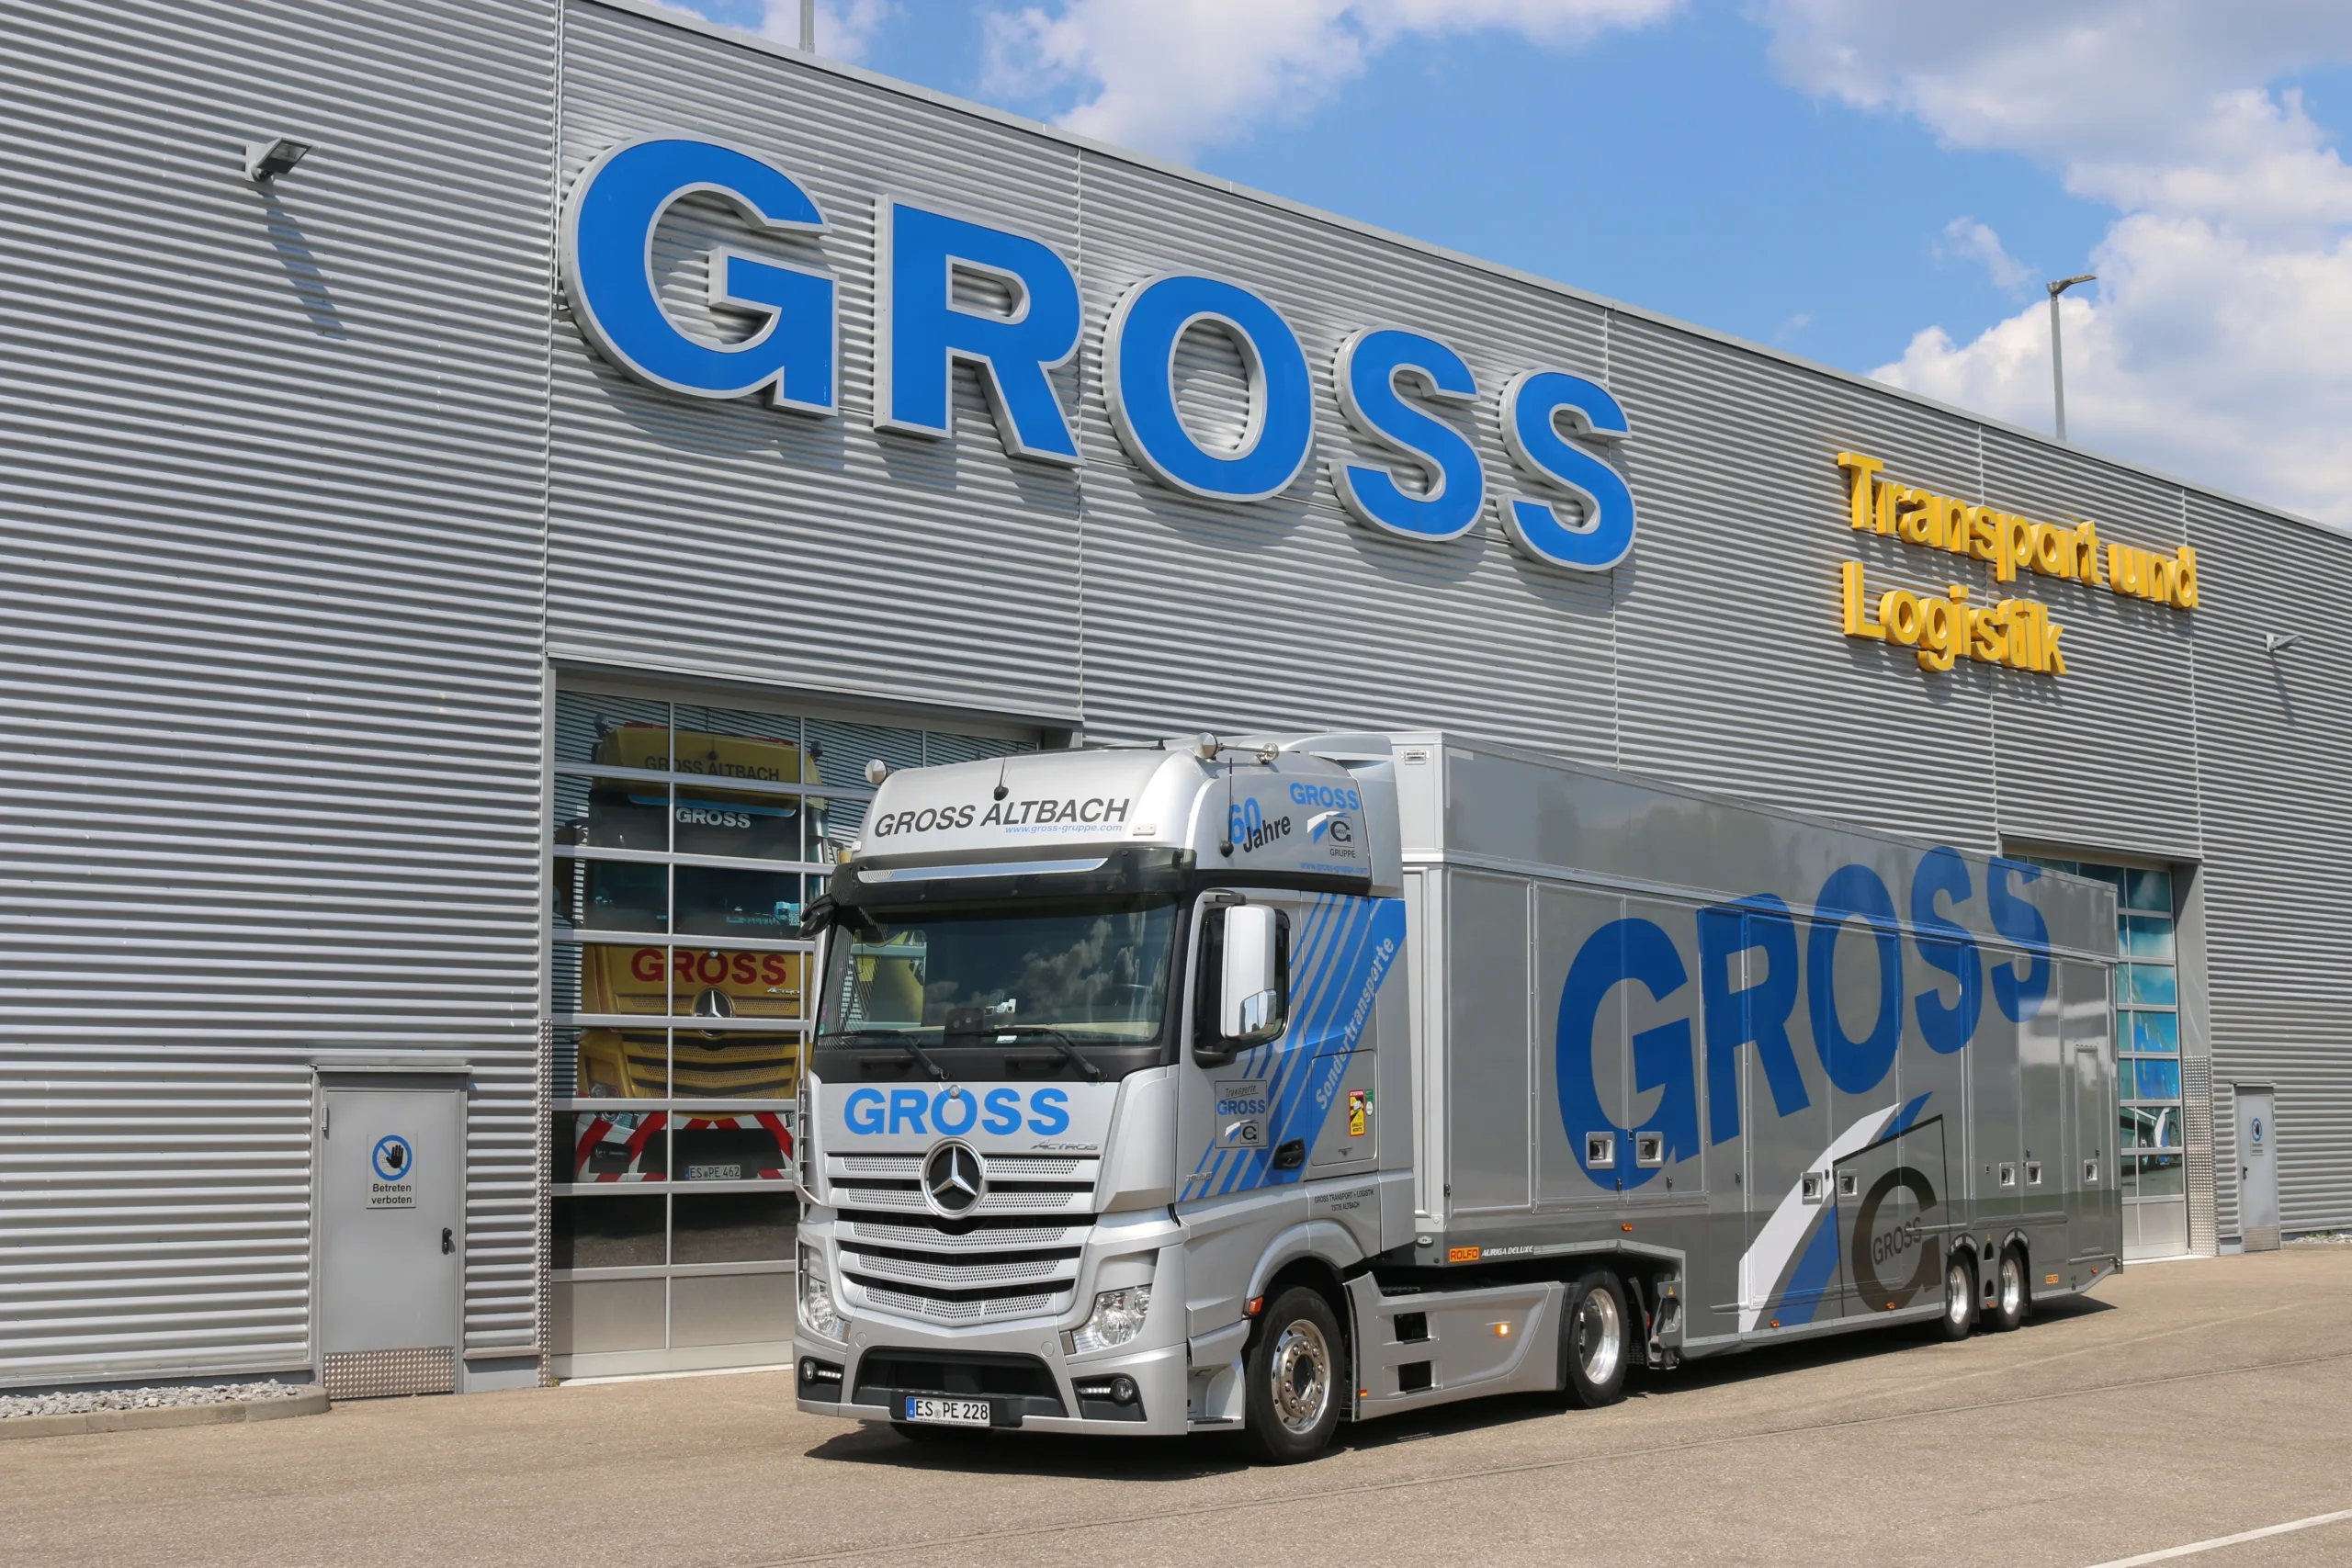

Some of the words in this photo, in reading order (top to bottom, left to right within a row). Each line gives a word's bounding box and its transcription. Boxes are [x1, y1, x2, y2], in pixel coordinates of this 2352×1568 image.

[560, 131, 1637, 571] GROSS
[1838, 451, 2103, 586] Transport
[2108, 543, 2199, 610] und
[1842, 561, 2067, 675] Logistik
[645, 755, 704, 774] GROSS
[708, 762, 780, 781] ALTBACH
[1289, 782, 1360, 811] GROSS
[676, 807, 751, 829] GROSS
[875, 805, 977, 838] GROSS
[979, 797, 1130, 827] ALTBACH
[1005, 824, 1123, 834] www.gross-gruppe.com
[1227, 797, 1261, 845] 60
[1243, 816, 1291, 853] Jahre
[1329, 848, 1356, 859] GRUPPE
[631, 948, 787, 987] GROSS
[1316, 937, 1396, 1110] Sondertransporte
[1556, 845, 2051, 1191] GROSS
[843, 1088, 1070, 1135] GROSS
[1216, 1100, 1266, 1115] GROSS
[372, 1183, 412, 1192] Betreten
[690, 1167, 703, 1179] ES
[708, 1167, 721, 1178] PE
[723, 1166, 740, 1177] 462
[371, 1195, 413, 1204] verboten
[1450, 1248, 1478, 1260] ROLFO
[1481, 1247, 1507, 1257] AURIGA
[1508, 1246, 1533, 1254] DELUXE
[1872, 1217, 1923, 1265] GROSS
[916, 1401, 933, 1416] ES
[943, 1402, 959, 1418] PE
[963, 1404, 989, 1420] 228
